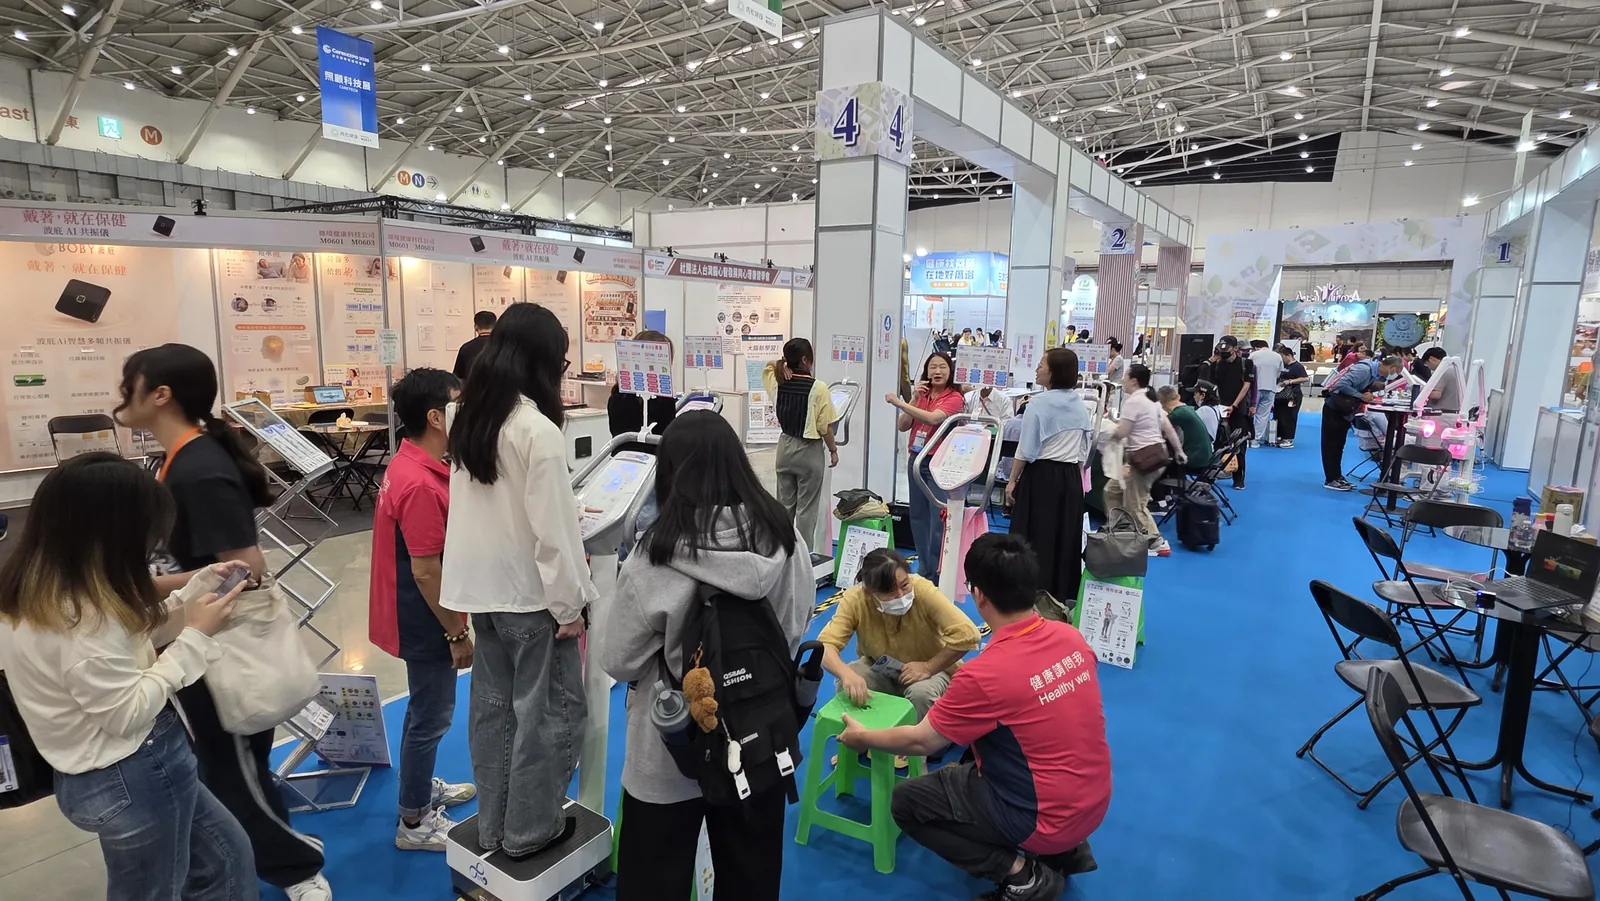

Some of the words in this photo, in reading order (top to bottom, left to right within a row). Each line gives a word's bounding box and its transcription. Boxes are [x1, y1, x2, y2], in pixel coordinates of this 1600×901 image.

[325, 71, 371, 91] 照顧科技展
[66, 116, 79, 129] 東
[833, 96, 860, 146] 4
[889, 104, 904, 152] 4
[144, 129, 158, 143] M
[400, 174, 409, 183] M
[414, 176, 422, 186] N
[80, 228, 110, 237] 共振儀
[1111, 228, 1126, 250] 2
[58, 243, 95, 254] BOBY
[1496, 242, 1511, 263] 1
[1030, 651, 1084, 691] 健康請問我
[1038, 680, 1075, 706] Healthy
[1074, 670, 1090, 685] way
